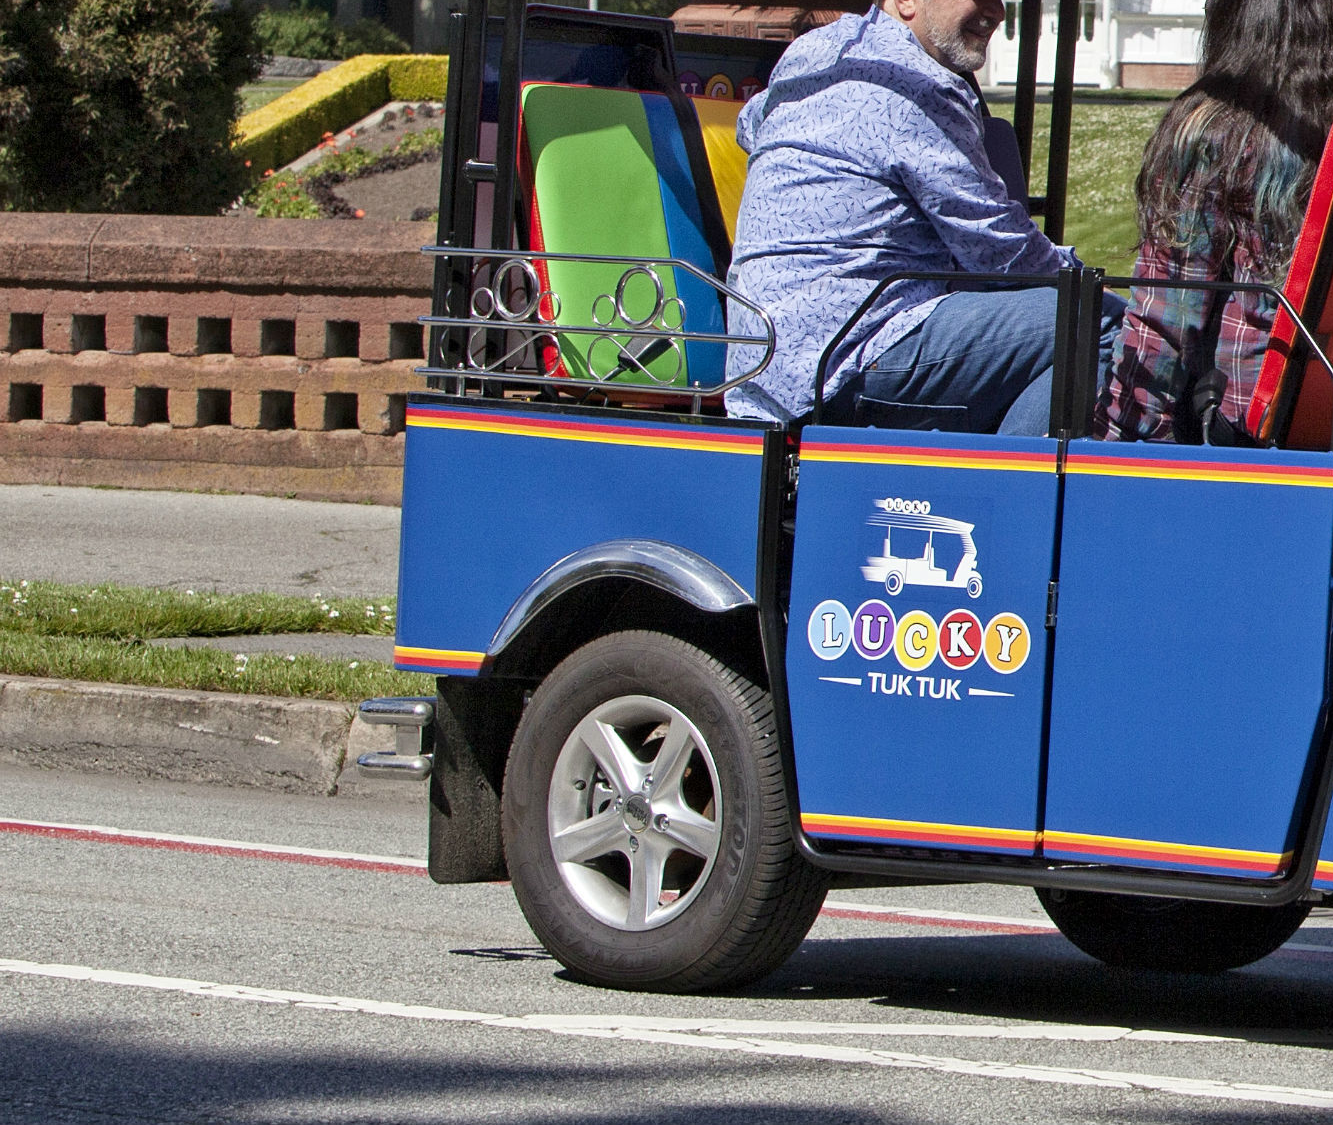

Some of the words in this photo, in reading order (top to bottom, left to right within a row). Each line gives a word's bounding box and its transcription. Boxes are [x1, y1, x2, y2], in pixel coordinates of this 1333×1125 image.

[887, 500, 929, 512] LUCKY
[821, 612, 1022, 663] LUCKY
[868, 672, 912, 696] TUK
[916, 676, 961, 700] TUK
